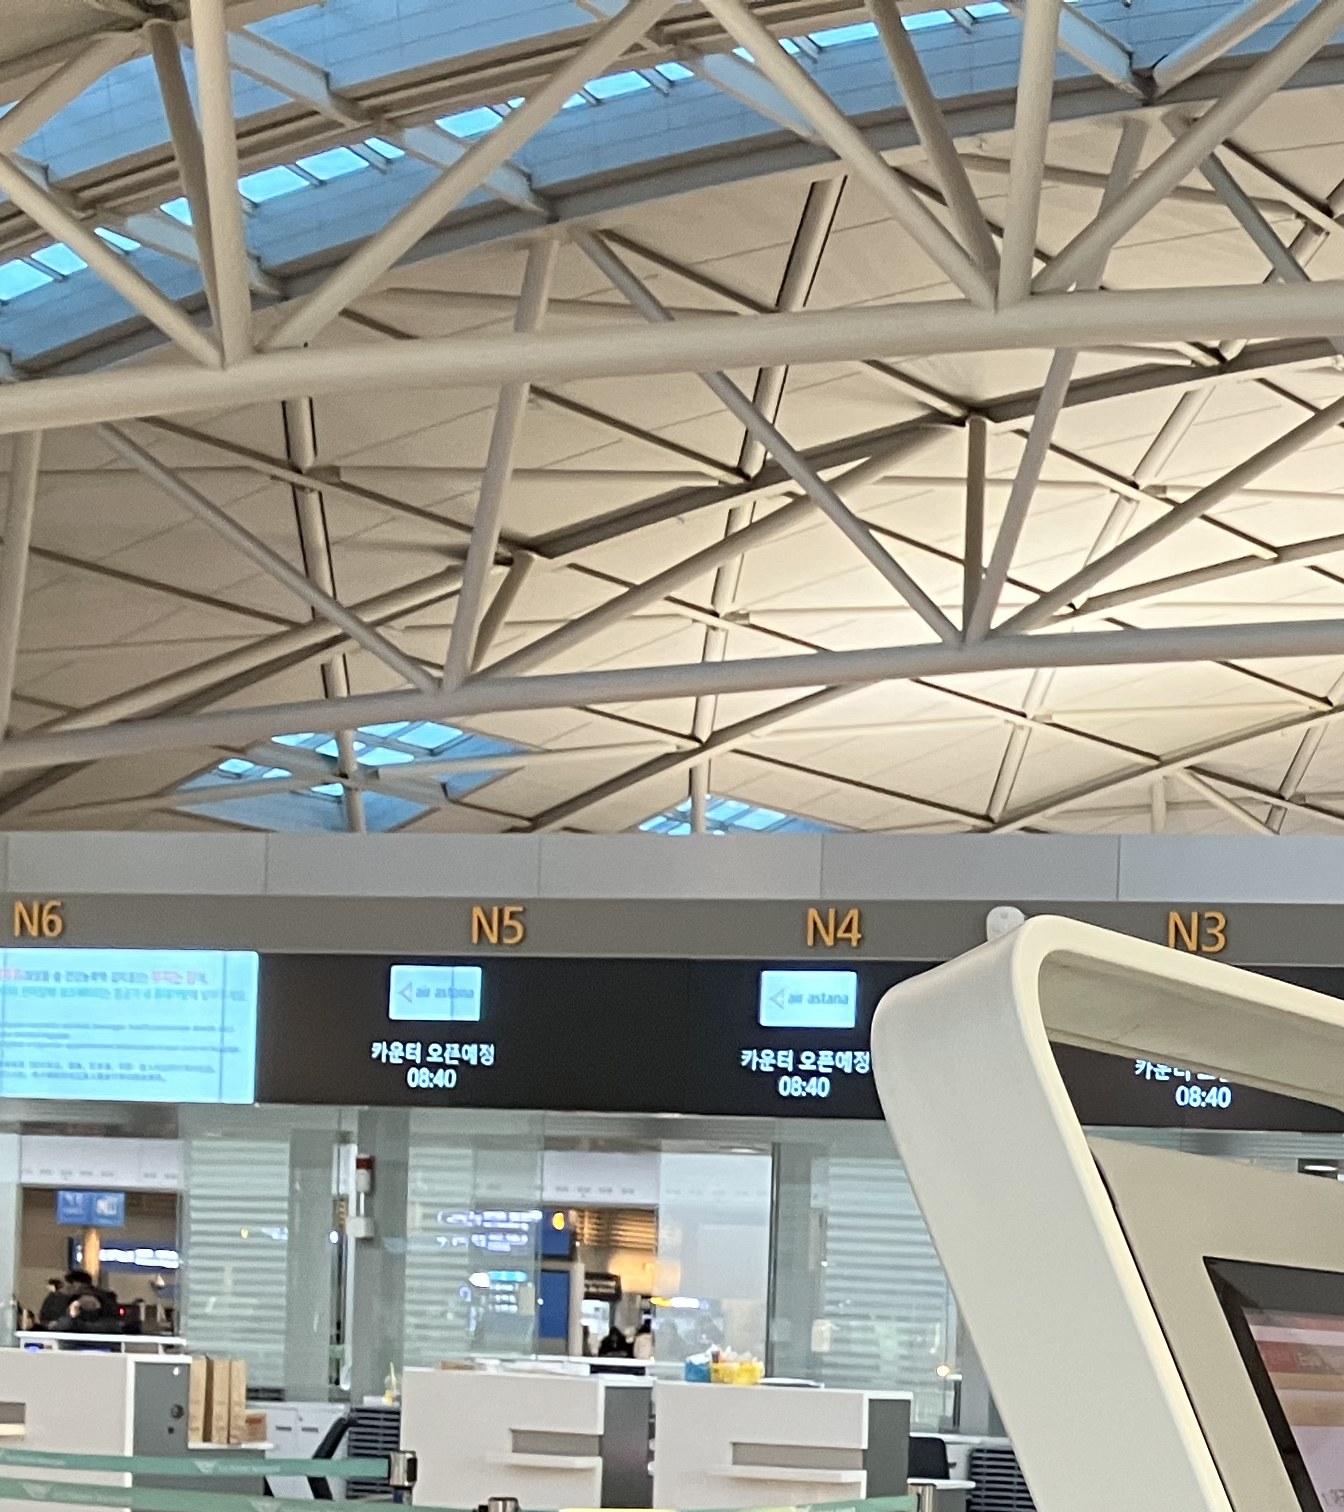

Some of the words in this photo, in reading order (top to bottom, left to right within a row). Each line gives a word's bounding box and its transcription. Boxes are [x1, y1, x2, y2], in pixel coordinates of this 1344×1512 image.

[14, 900, 63, 938] N6
[471, 905, 525, 944] N5
[806, 907, 861, 947] N4
[1168, 911, 1227, 952] N3
[371, 1041, 421, 1064] 카운터
[426, 1043, 495, 1066] 오픈예정
[740, 1049, 794, 1072] 카운터
[798, 1050, 870, 1074] 오픈예정
[406, 1067, 457, 1088] 08:40
[778, 1075, 830, 1098] 08:40
[1175, 1085, 1232, 1108] 08:40
